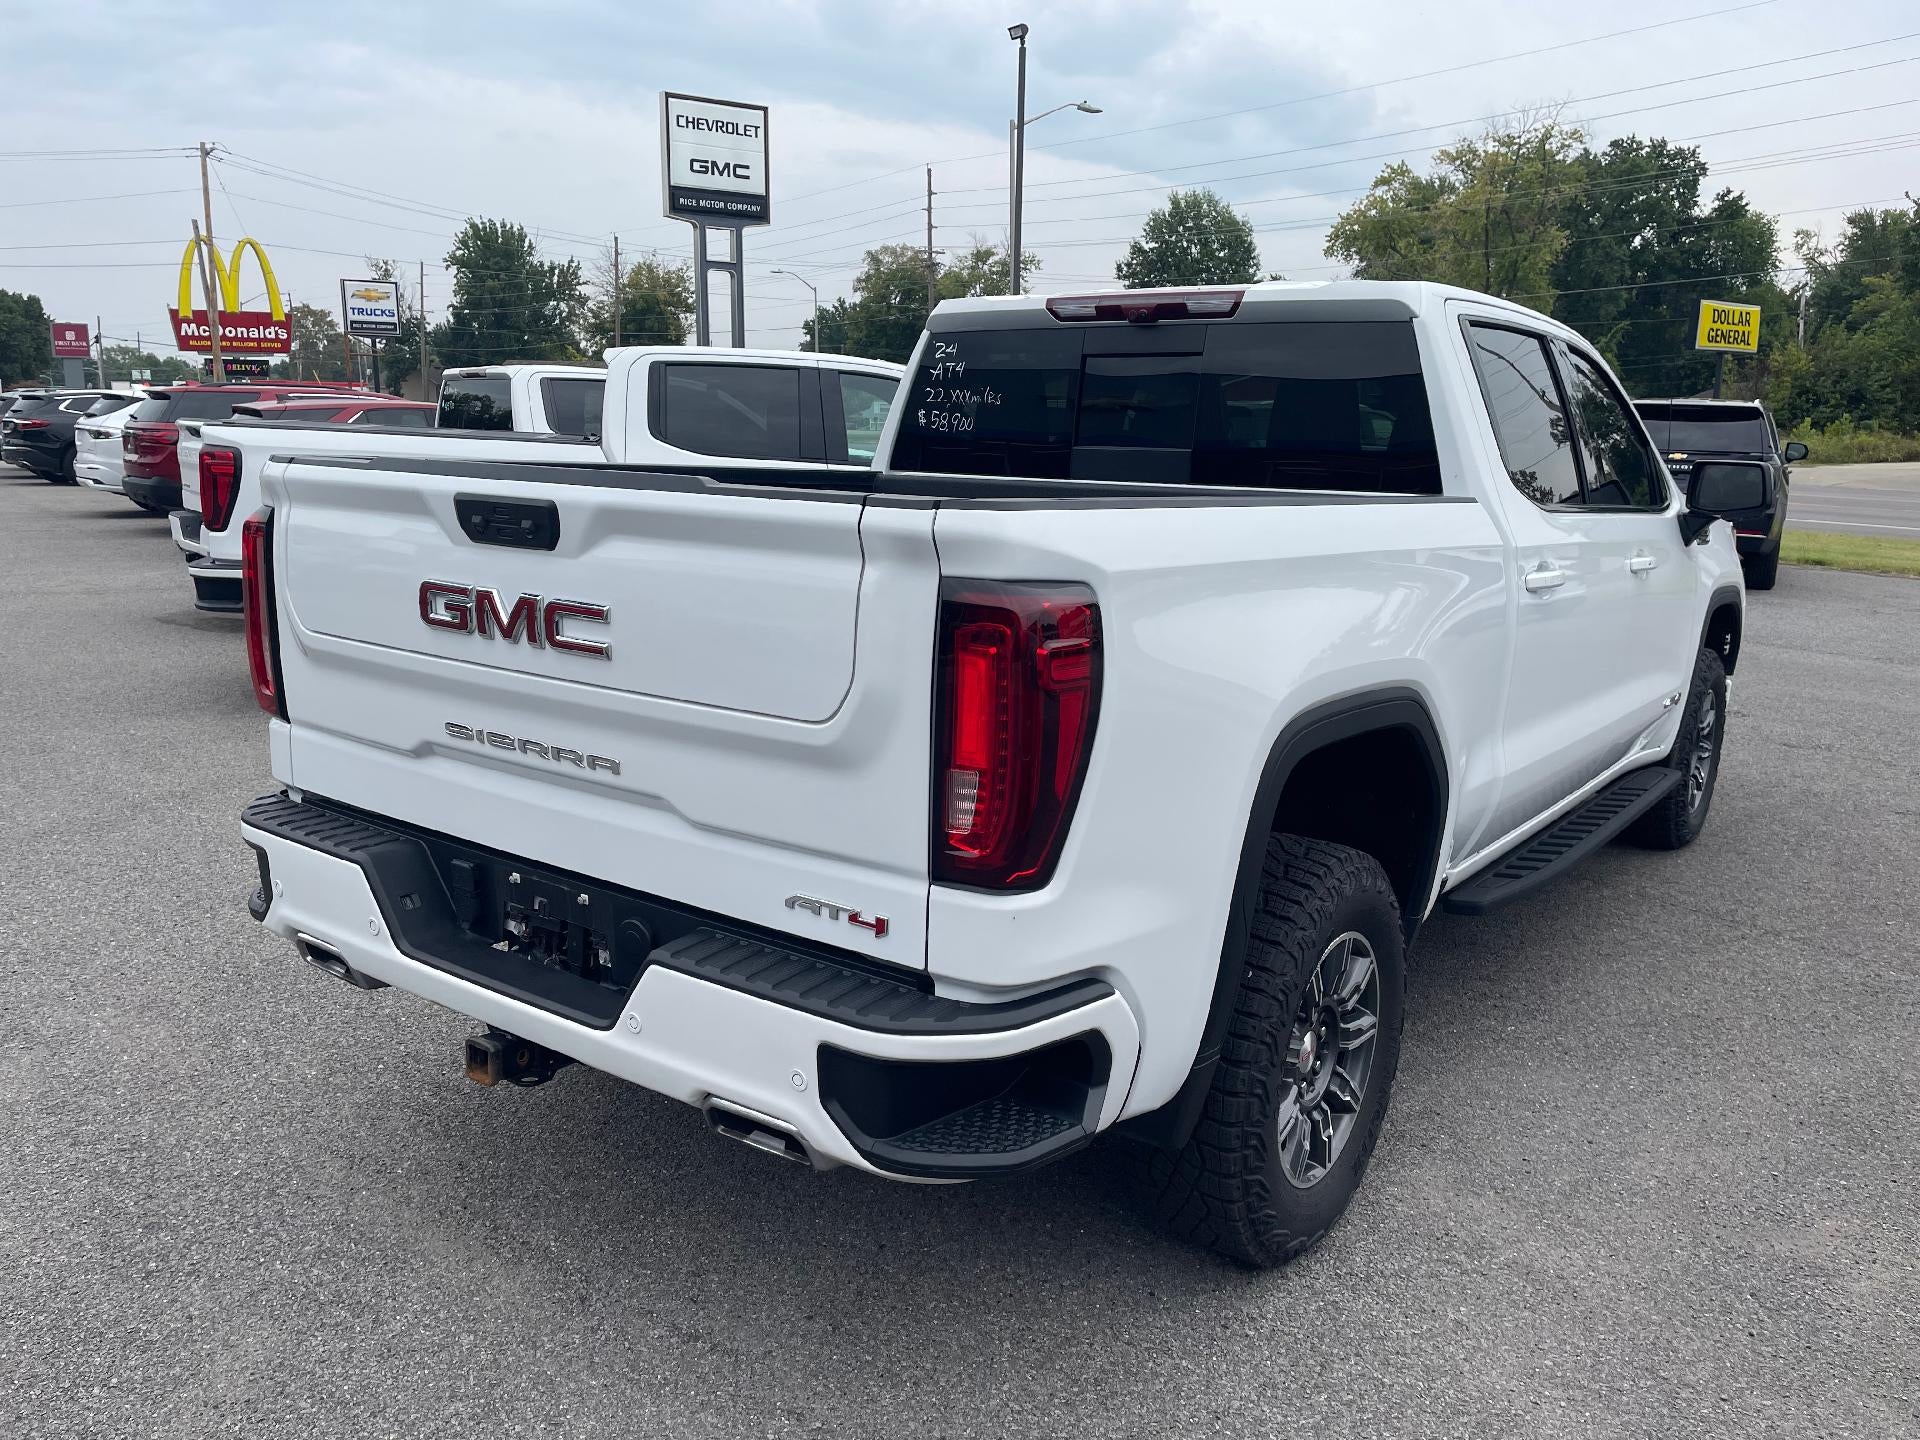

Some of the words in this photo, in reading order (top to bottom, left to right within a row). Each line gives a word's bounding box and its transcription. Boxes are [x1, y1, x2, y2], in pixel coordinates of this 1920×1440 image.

[676, 114, 761, 139] CHEVROLET
[689, 158, 751, 180] GMC
[679, 197, 698, 207] RICE
[699, 199, 725, 209] MOTOR
[727, 202, 761, 212] COMPANY
[350, 306, 396, 318] TRUCKS
[1712, 308, 1751, 327] DOLLAR
[1707, 327, 1752, 346] GENERAL
[929, 361, 966, 380] AT4
[418, 578, 613, 661] GMC
[444, 721, 622, 776] SIERRA
[784, 892, 889, 939] AT4
